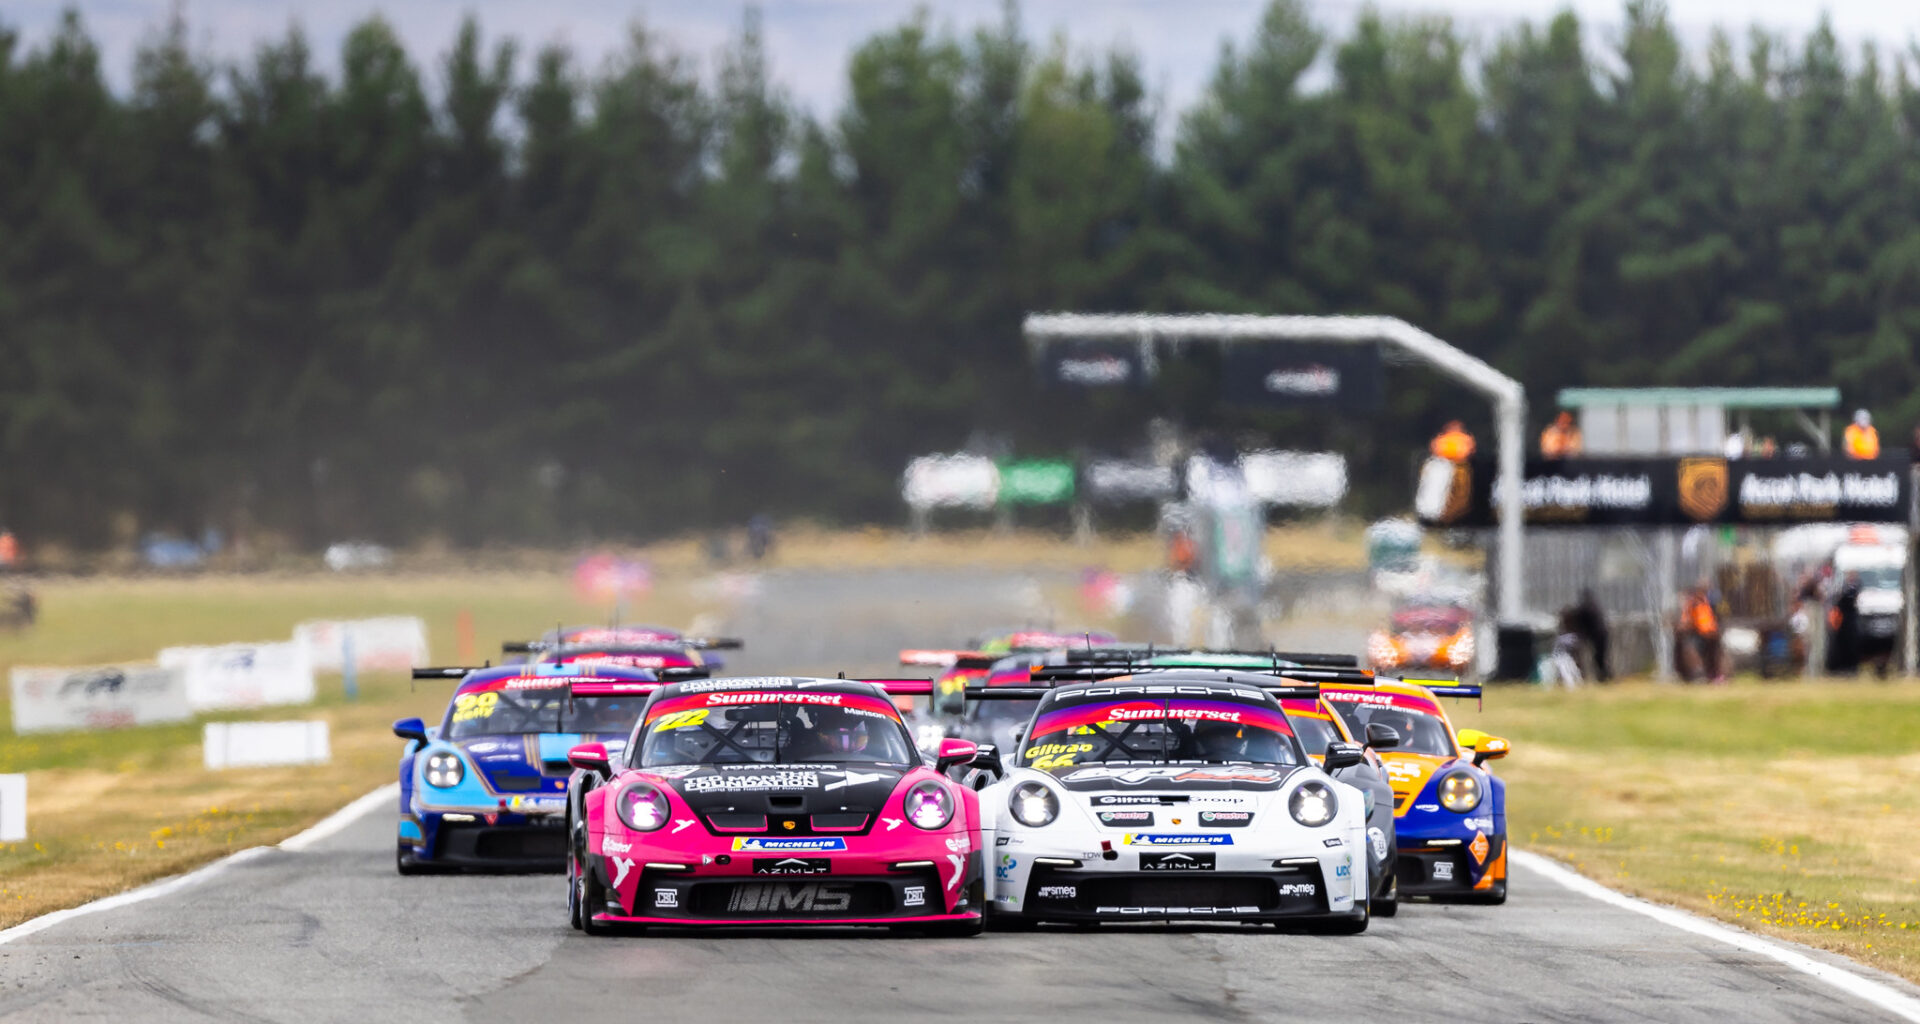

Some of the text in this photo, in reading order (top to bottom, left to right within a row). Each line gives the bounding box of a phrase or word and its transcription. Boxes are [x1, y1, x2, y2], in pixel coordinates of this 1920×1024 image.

[706, 692, 843, 705] Summerset
[1055, 685, 1266, 701] PORSCHE
[1108, 707, 1242, 722] Summerset
[764, 840, 836, 848] MICHELIN
[758, 867, 827, 875] AZIMUT
[1096, 905, 1260, 914] PORSCHE
